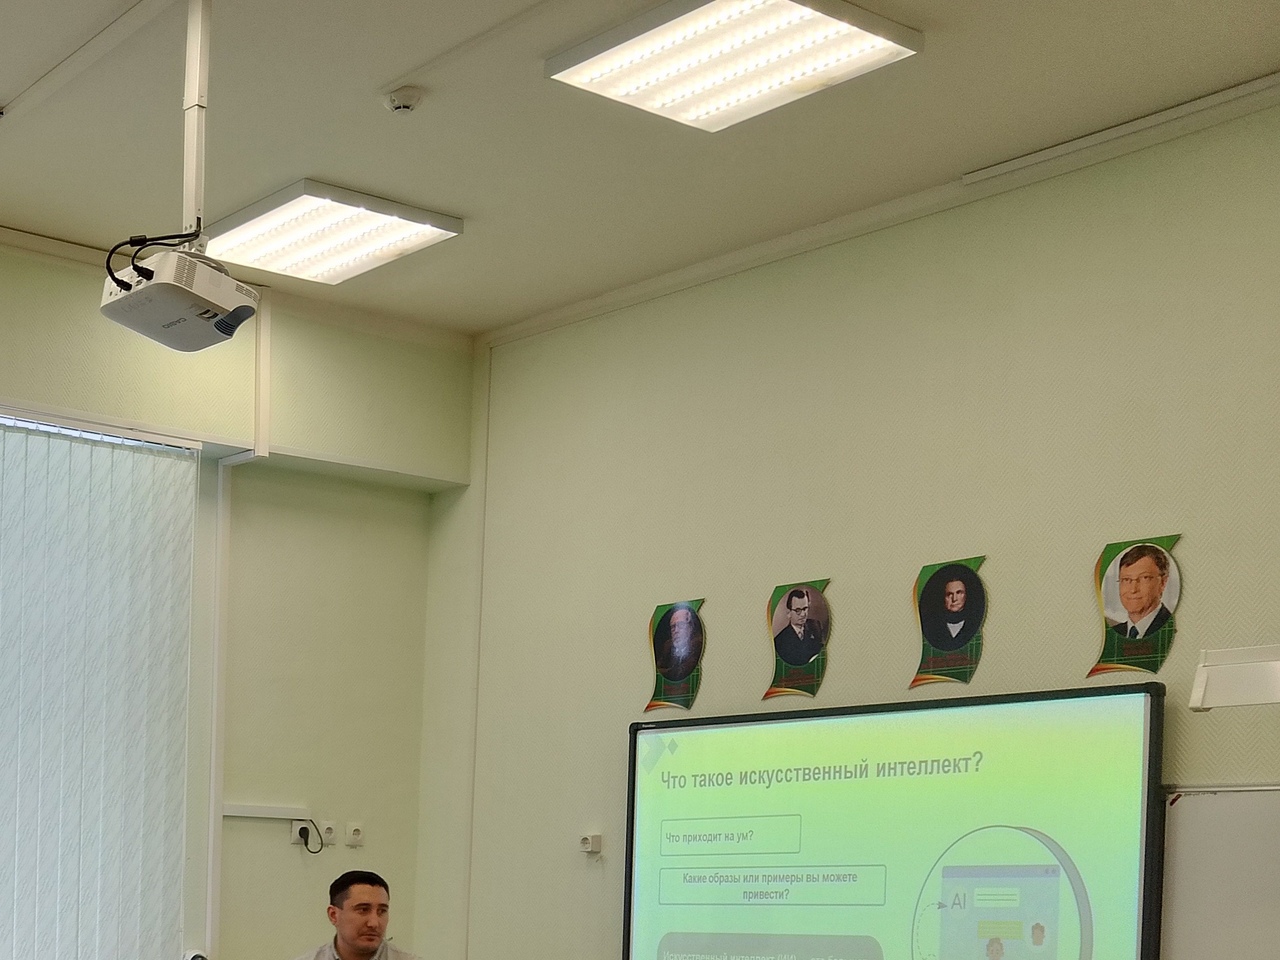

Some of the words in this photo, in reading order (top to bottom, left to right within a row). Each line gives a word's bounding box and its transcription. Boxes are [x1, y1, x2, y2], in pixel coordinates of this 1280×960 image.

[162, 317, 187, 329] CASIO
[661, 771, 687, 789] Что
[691, 768, 734, 788] такое
[738, 758, 870, 789] искусственный
[875, 751, 984, 778] интеллект?
[665, 832, 680, 843] Что
[682, 832, 723, 845] приходит
[724, 833, 735, 842] на
[736, 830, 754, 844] ум?
[682, 872, 707, 884] Какие
[708, 872, 741, 886] образы
[742, 874, 760, 884] или
[761, 873, 804, 886] примеры
[806, 873, 820, 883] вы
[822, 872, 858, 883] можете
[742, 888, 790, 902] привести?
[950, 893, 967, 910] AI
